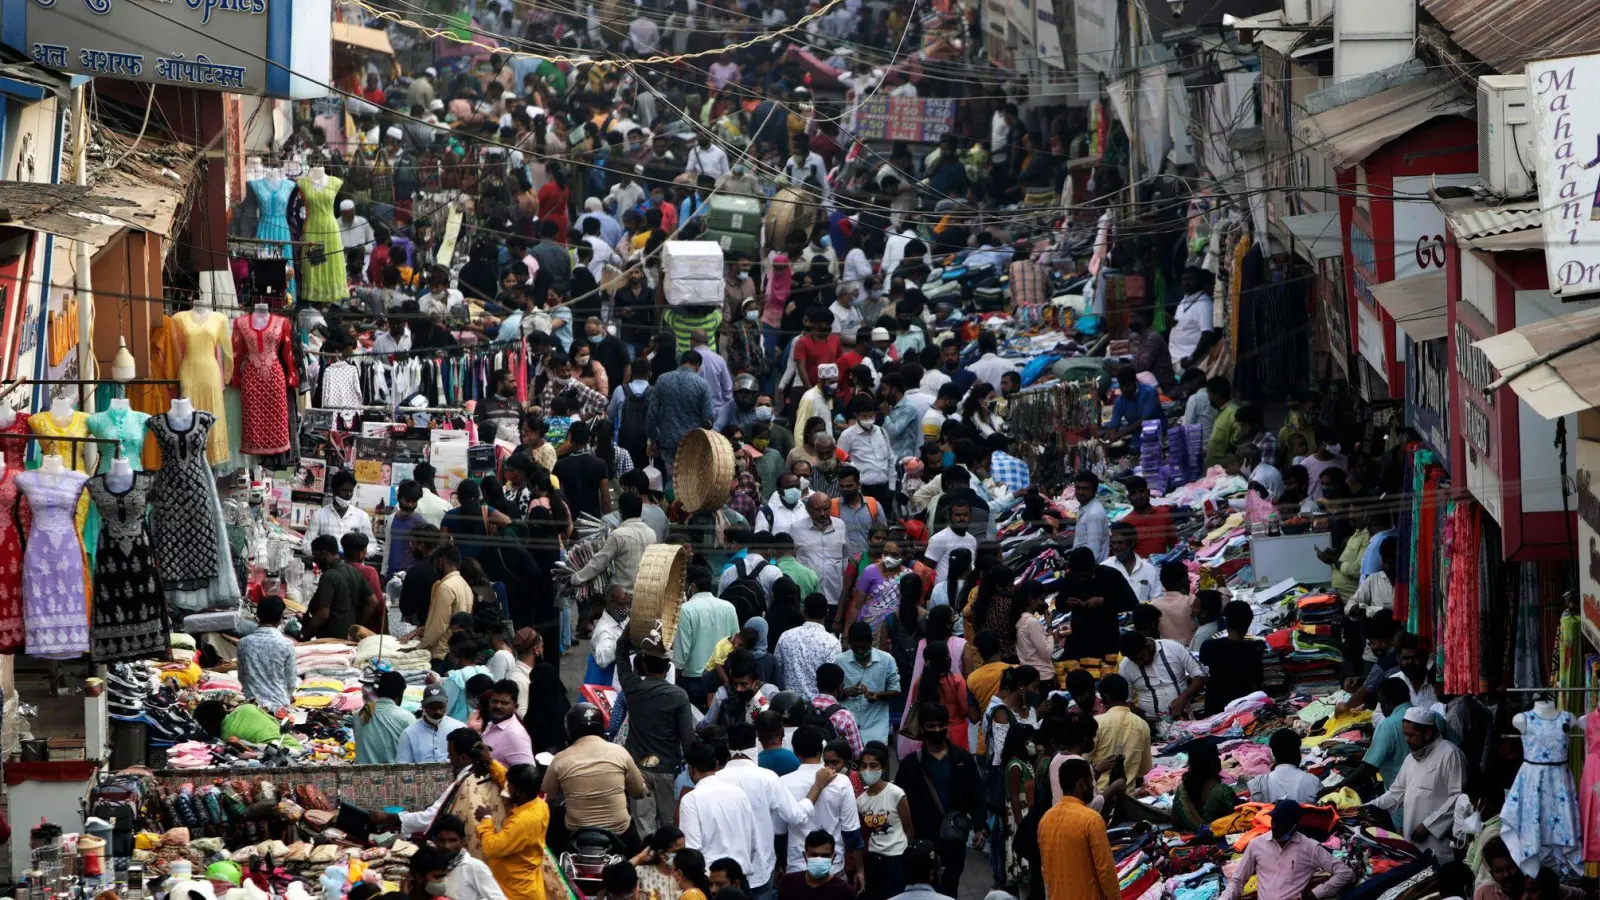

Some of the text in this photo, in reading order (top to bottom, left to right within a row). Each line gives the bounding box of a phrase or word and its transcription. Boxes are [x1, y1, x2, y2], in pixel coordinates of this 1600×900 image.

[31, 42, 69, 68] अल
[78, 48, 145, 77] अशरफ
[926, 98, 951, 107] SALE
[891, 131, 916, 139] SALE
[1538, 67, 1582, 245] Maharani
[1416, 235, 1446, 269] GO
[1558, 260, 1600, 286] Dr
